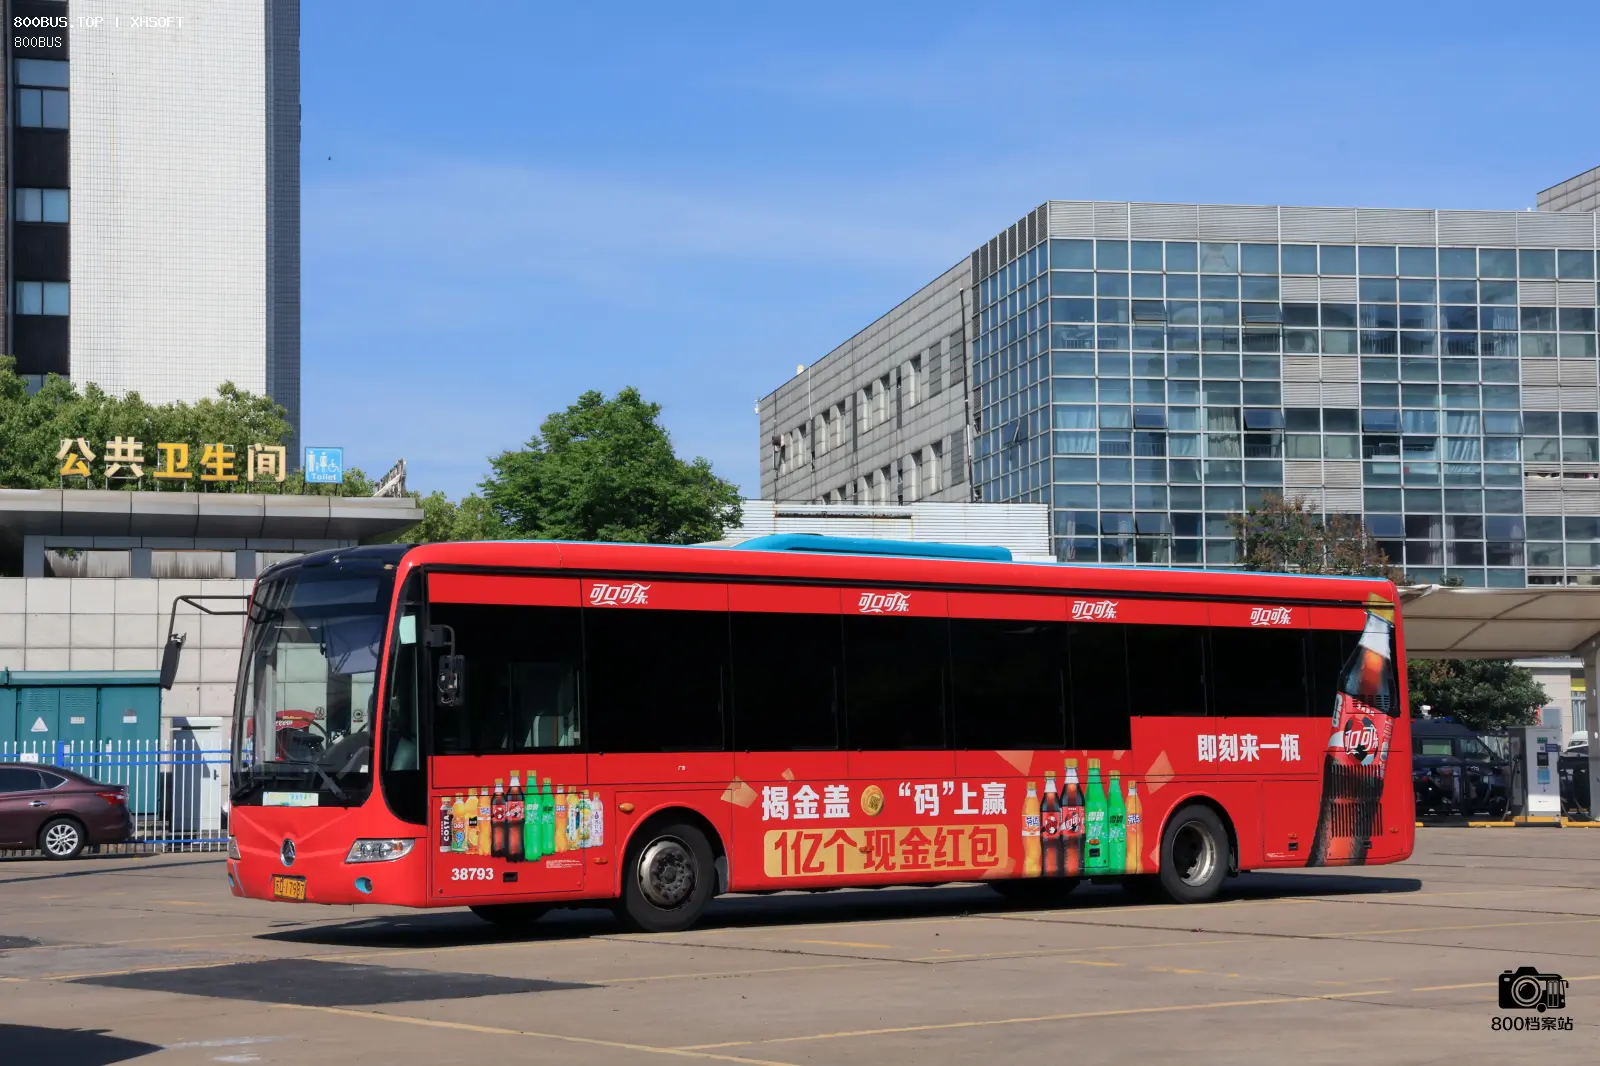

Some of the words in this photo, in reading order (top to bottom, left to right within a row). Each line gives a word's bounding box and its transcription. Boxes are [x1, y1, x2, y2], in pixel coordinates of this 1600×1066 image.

[55, 435, 287, 483] 公共卫生间
[311, 473, 337, 481] Toilet
[589, 582, 651, 607] 可口可乐
[858, 591, 912, 614] 可口可乐
[1071, 600, 1119, 621] 可口可乐
[1250, 606, 1293, 626] 可口可乐
[1197, 733, 1301, 763] 即刻来一瓶
[761, 784, 850, 821] 揭金盖
[774, 826, 1000, 876] 1亿个现金红包
[451, 867, 494, 881] 38793
